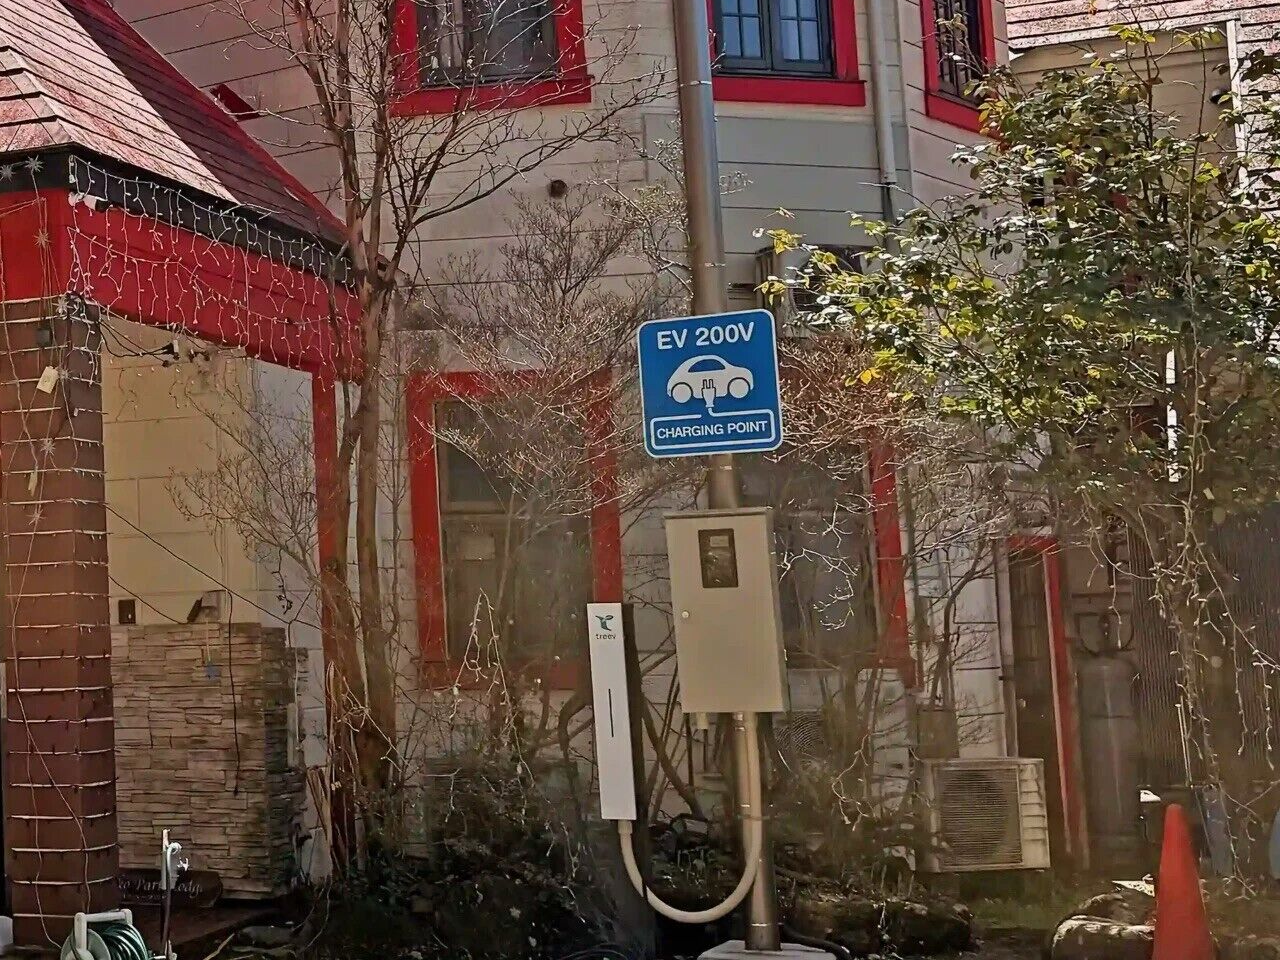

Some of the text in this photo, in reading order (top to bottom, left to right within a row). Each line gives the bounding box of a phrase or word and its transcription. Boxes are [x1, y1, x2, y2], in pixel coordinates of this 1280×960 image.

[657, 321, 755, 350] EV 200V
[656, 420, 768, 439] CHARGING POINT
